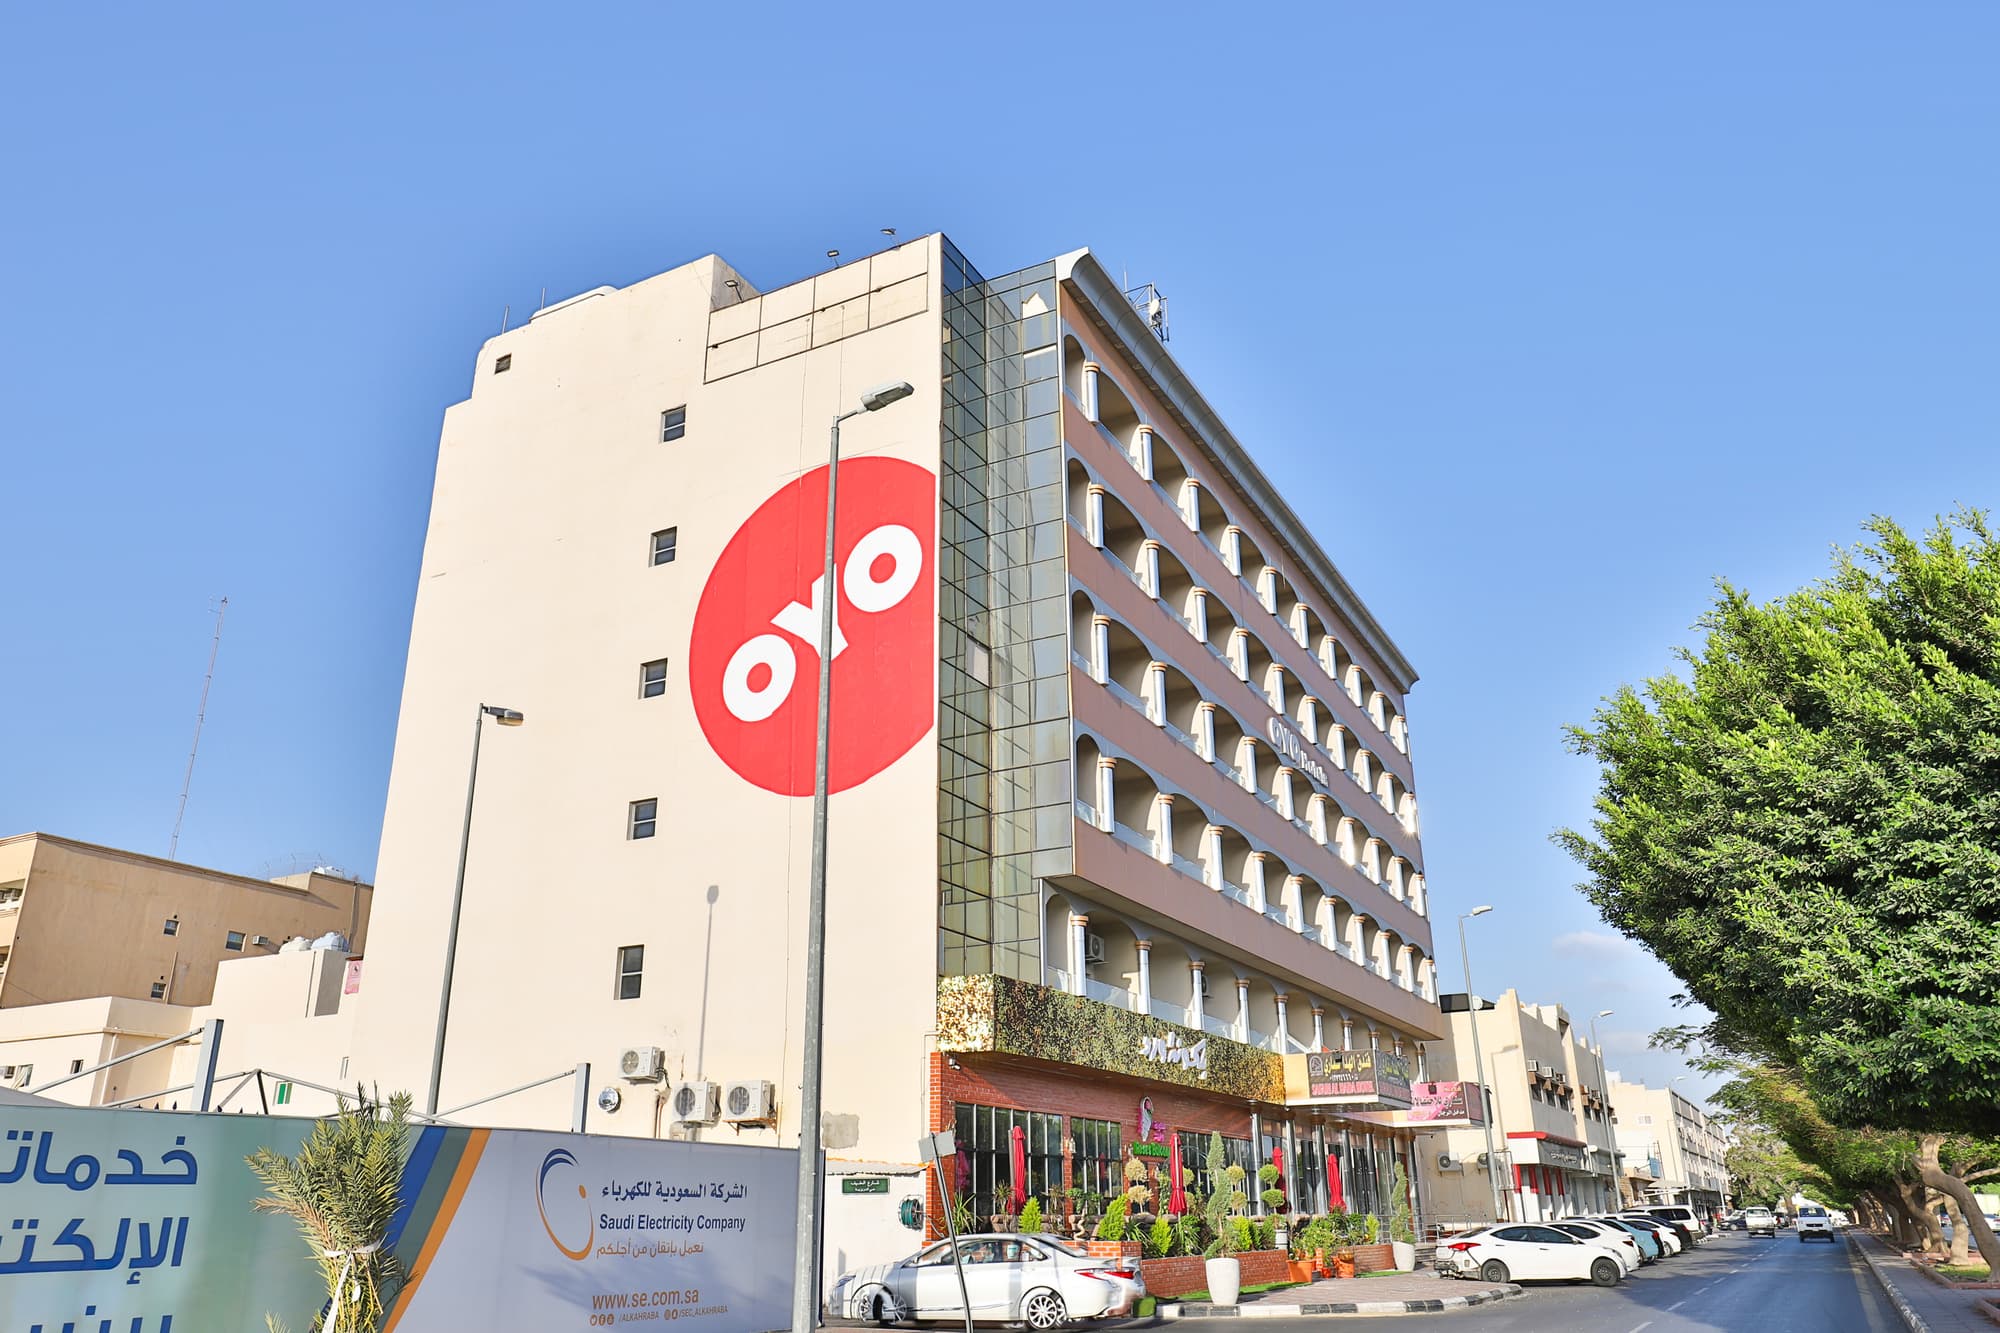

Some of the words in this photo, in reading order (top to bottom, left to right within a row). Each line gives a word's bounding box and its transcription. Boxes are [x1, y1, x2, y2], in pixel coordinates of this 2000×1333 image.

[722, 524, 924, 723] OYO
[601, 1179, 652, 1202] للكهرباء
[655, 1180, 707, 1203] السعودية
[710, 1182, 748, 1203] الشركة
[599, 1213, 634, 1230] Saudi
[637, 1214, 694, 1233] Electricity
[697, 1214, 746, 1233] Company
[0, 1216, 190, 1286] الإلكت
[596, 1237, 631, 1259] أجلكم
[632, 1243, 648, 1258] من
[679, 1239, 704, 1257] نعمل
[592, 1289, 699, 1310] www.se.com.sa
